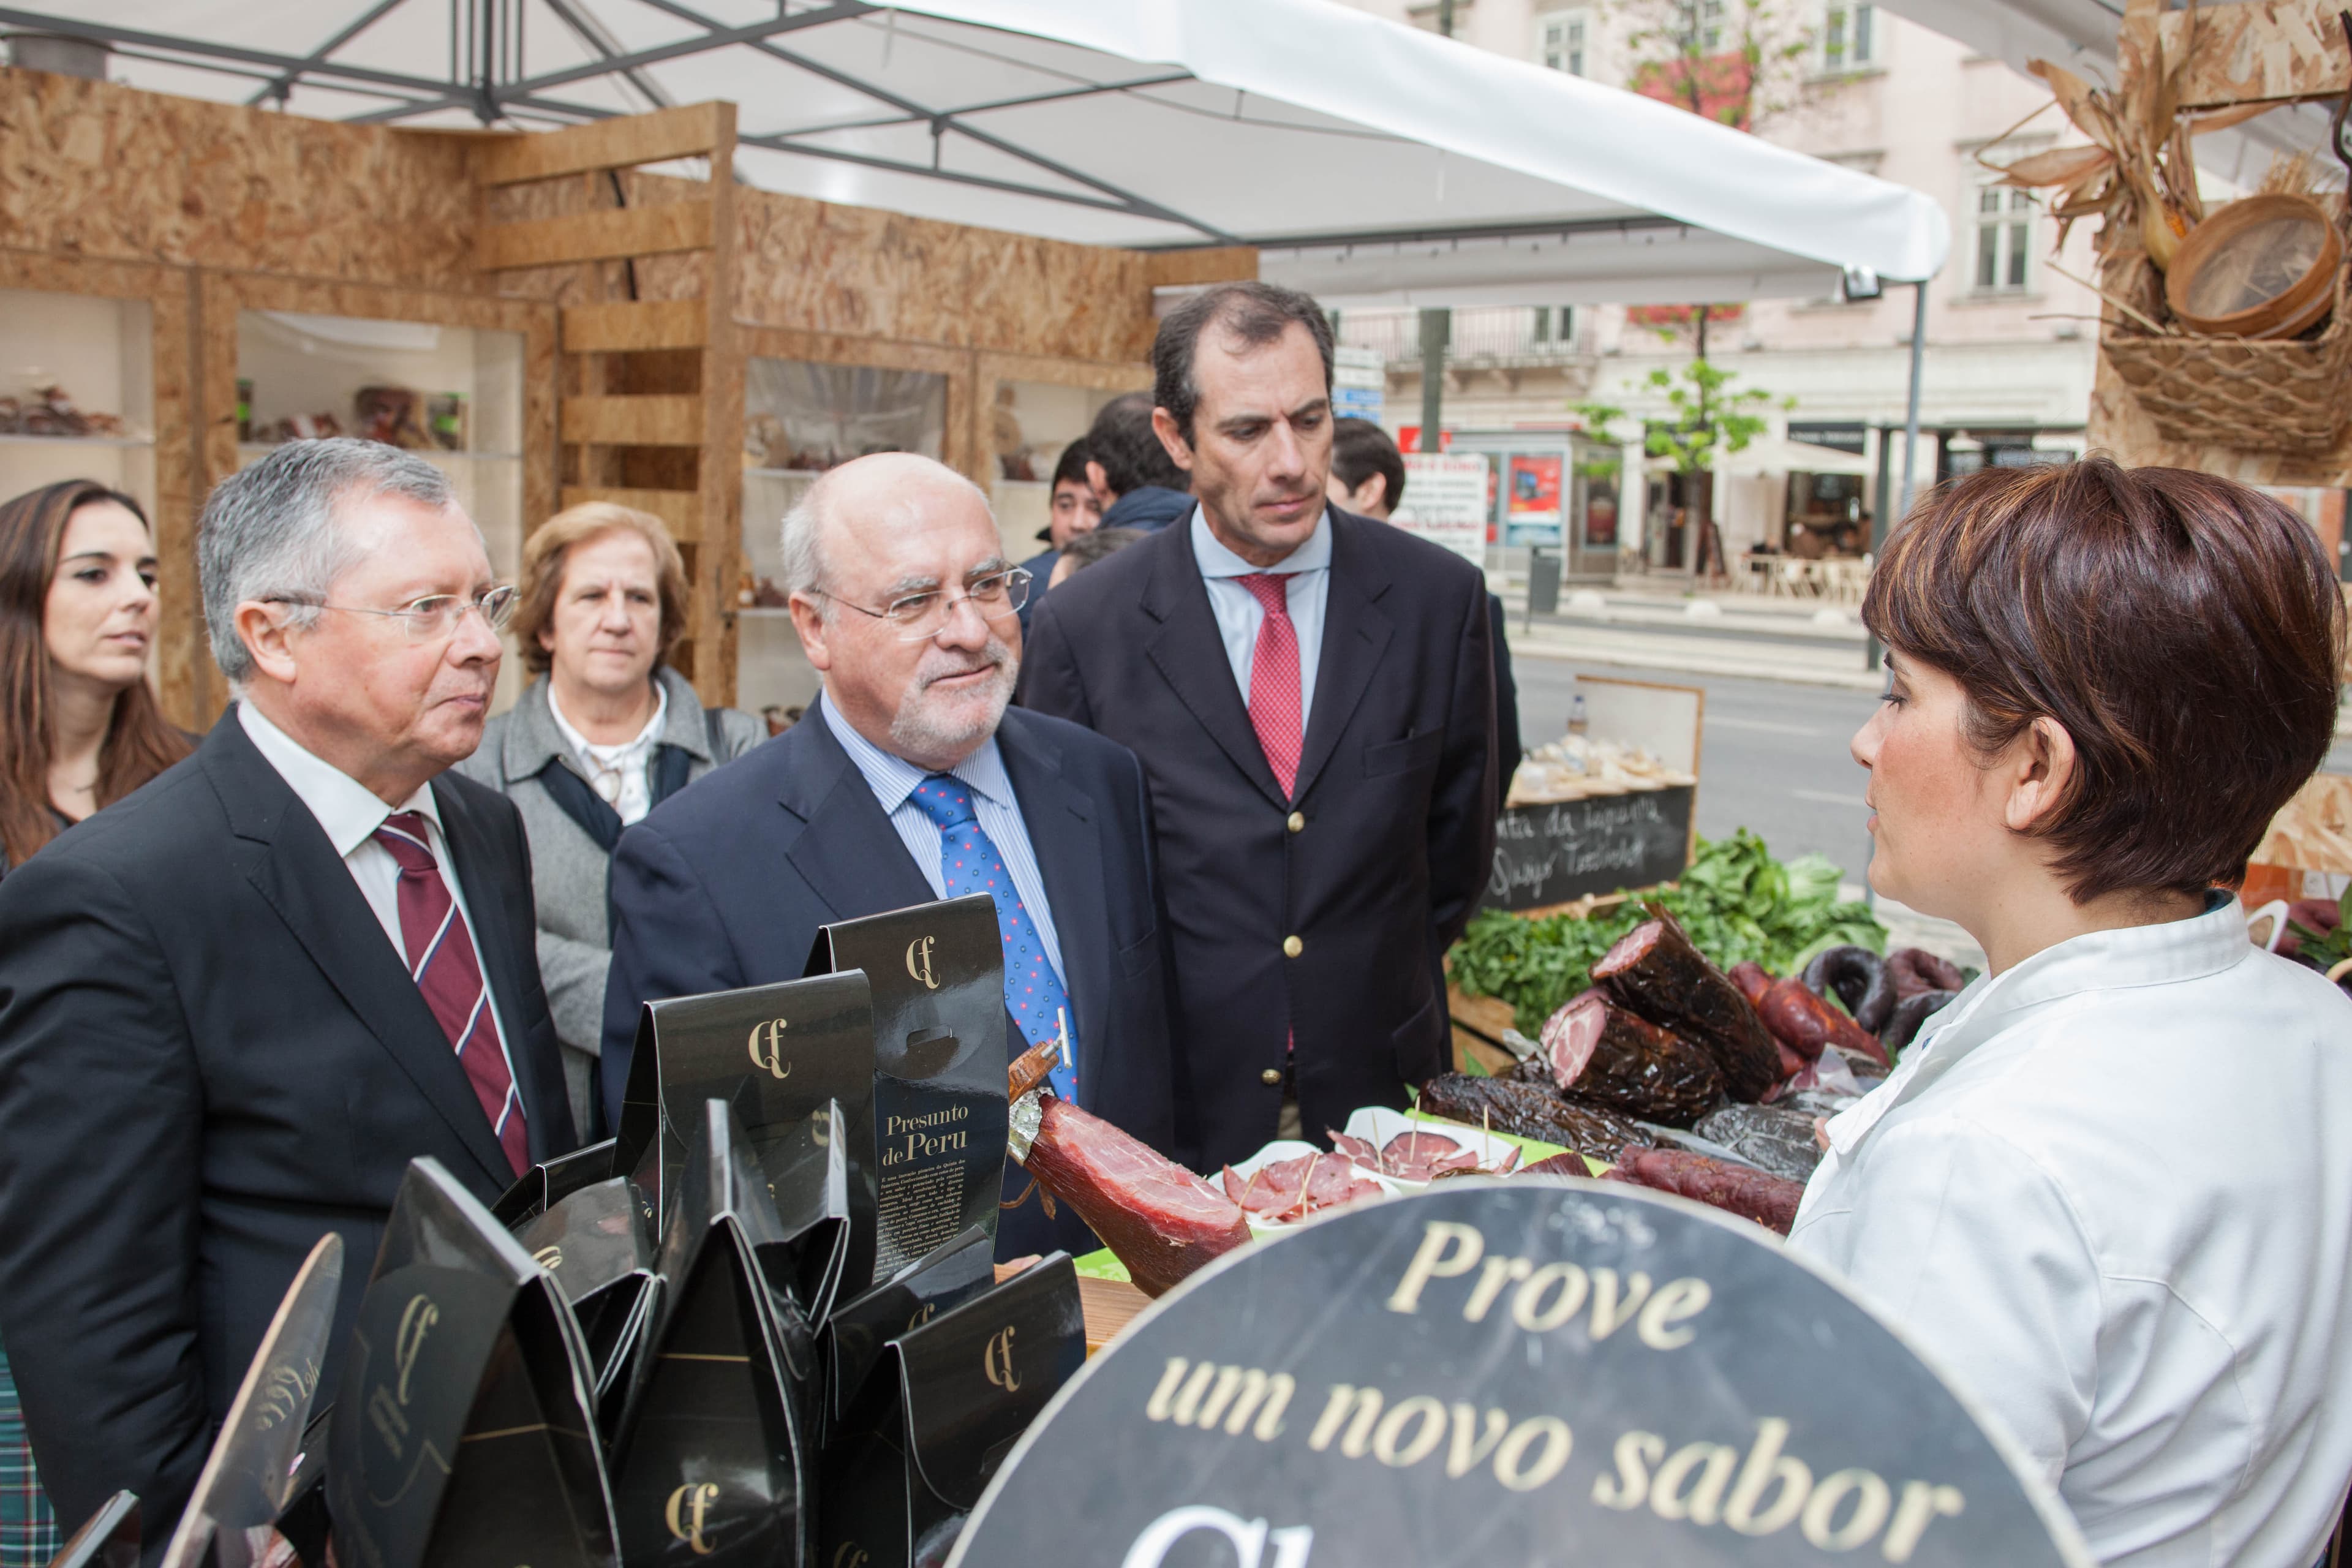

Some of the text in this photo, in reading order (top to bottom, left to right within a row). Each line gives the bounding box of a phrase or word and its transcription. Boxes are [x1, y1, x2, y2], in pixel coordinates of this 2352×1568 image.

[886, 1104, 968, 1136] Presunto
[883, 1131, 968, 1166] de Peru
[943, 1160, 957, 1169] Quinta
[1385, 1219, 1712, 1350] Prove
[1146, 1356, 1966, 1564] um novo sabor
